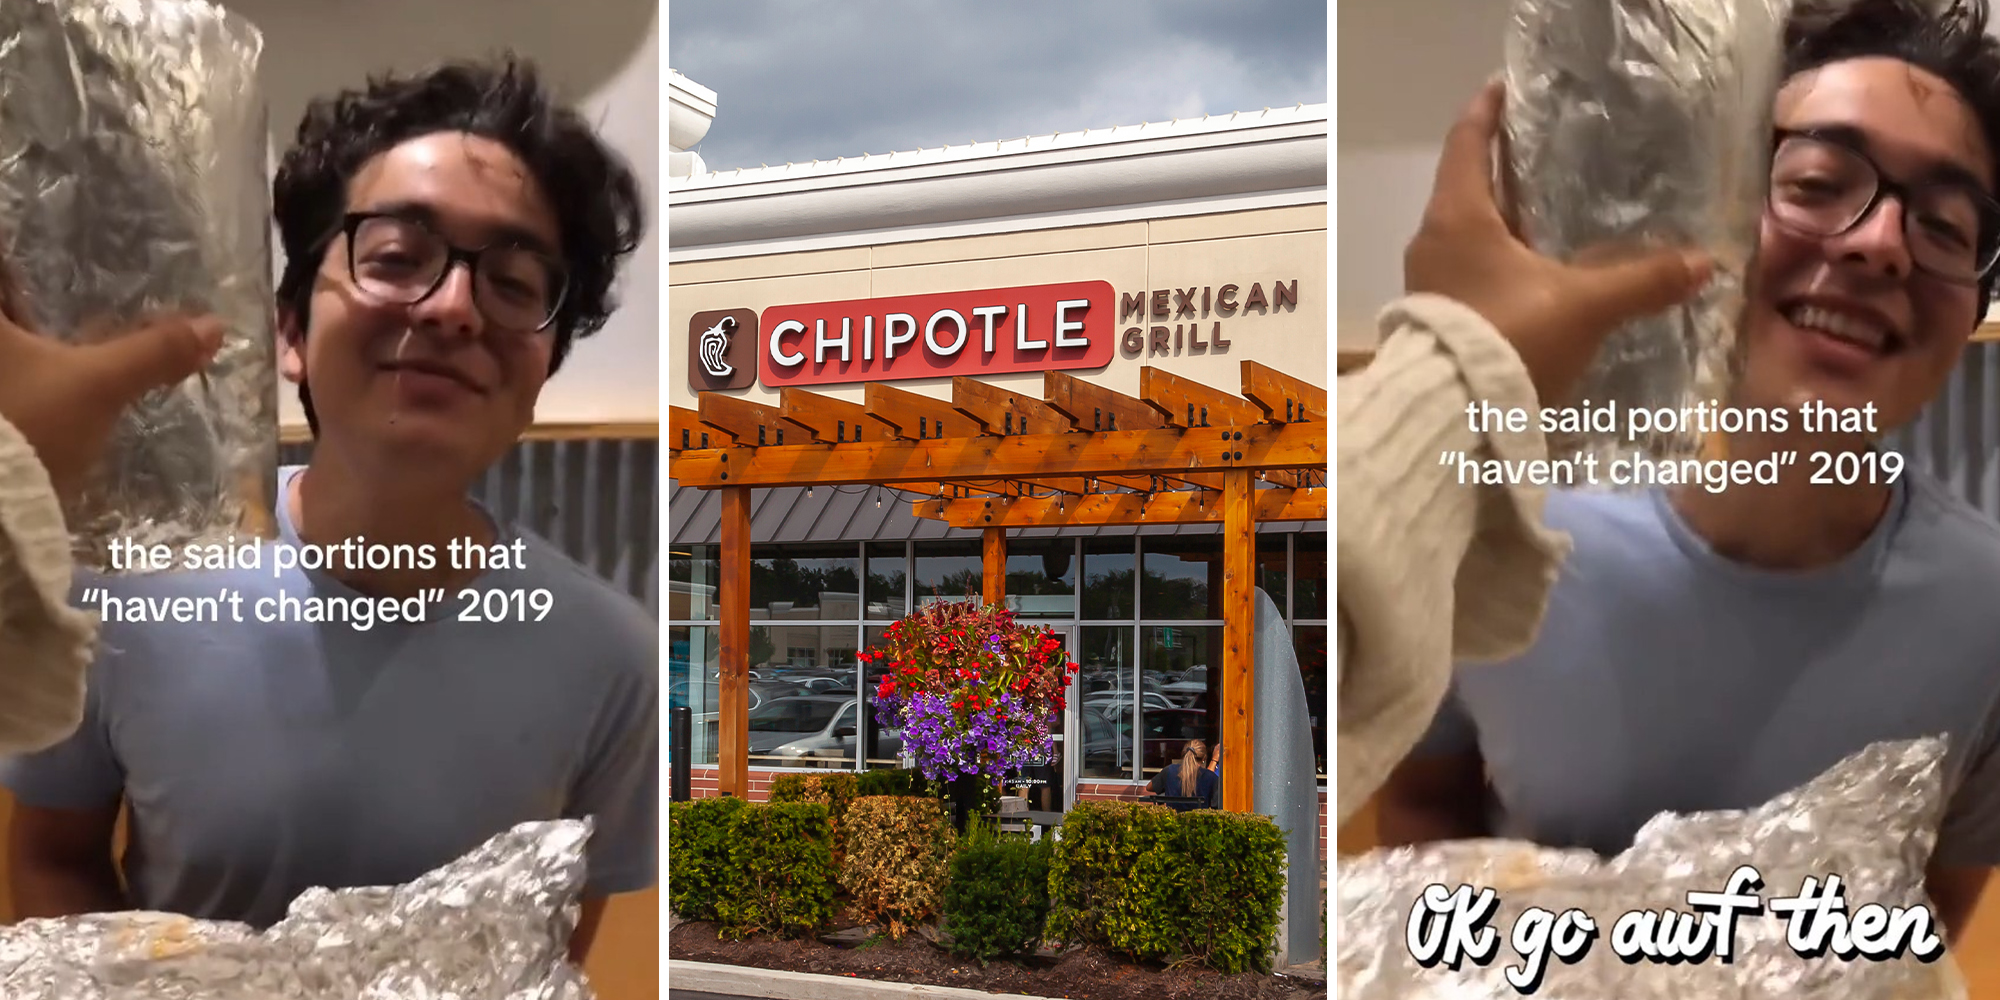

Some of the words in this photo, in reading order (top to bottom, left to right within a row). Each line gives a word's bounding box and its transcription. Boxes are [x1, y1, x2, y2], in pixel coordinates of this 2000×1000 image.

[1121, 279, 1298, 318] MEXICAN
[768, 297, 1091, 368] CHIPOTLE
[1121, 321, 1232, 353] GRILL
